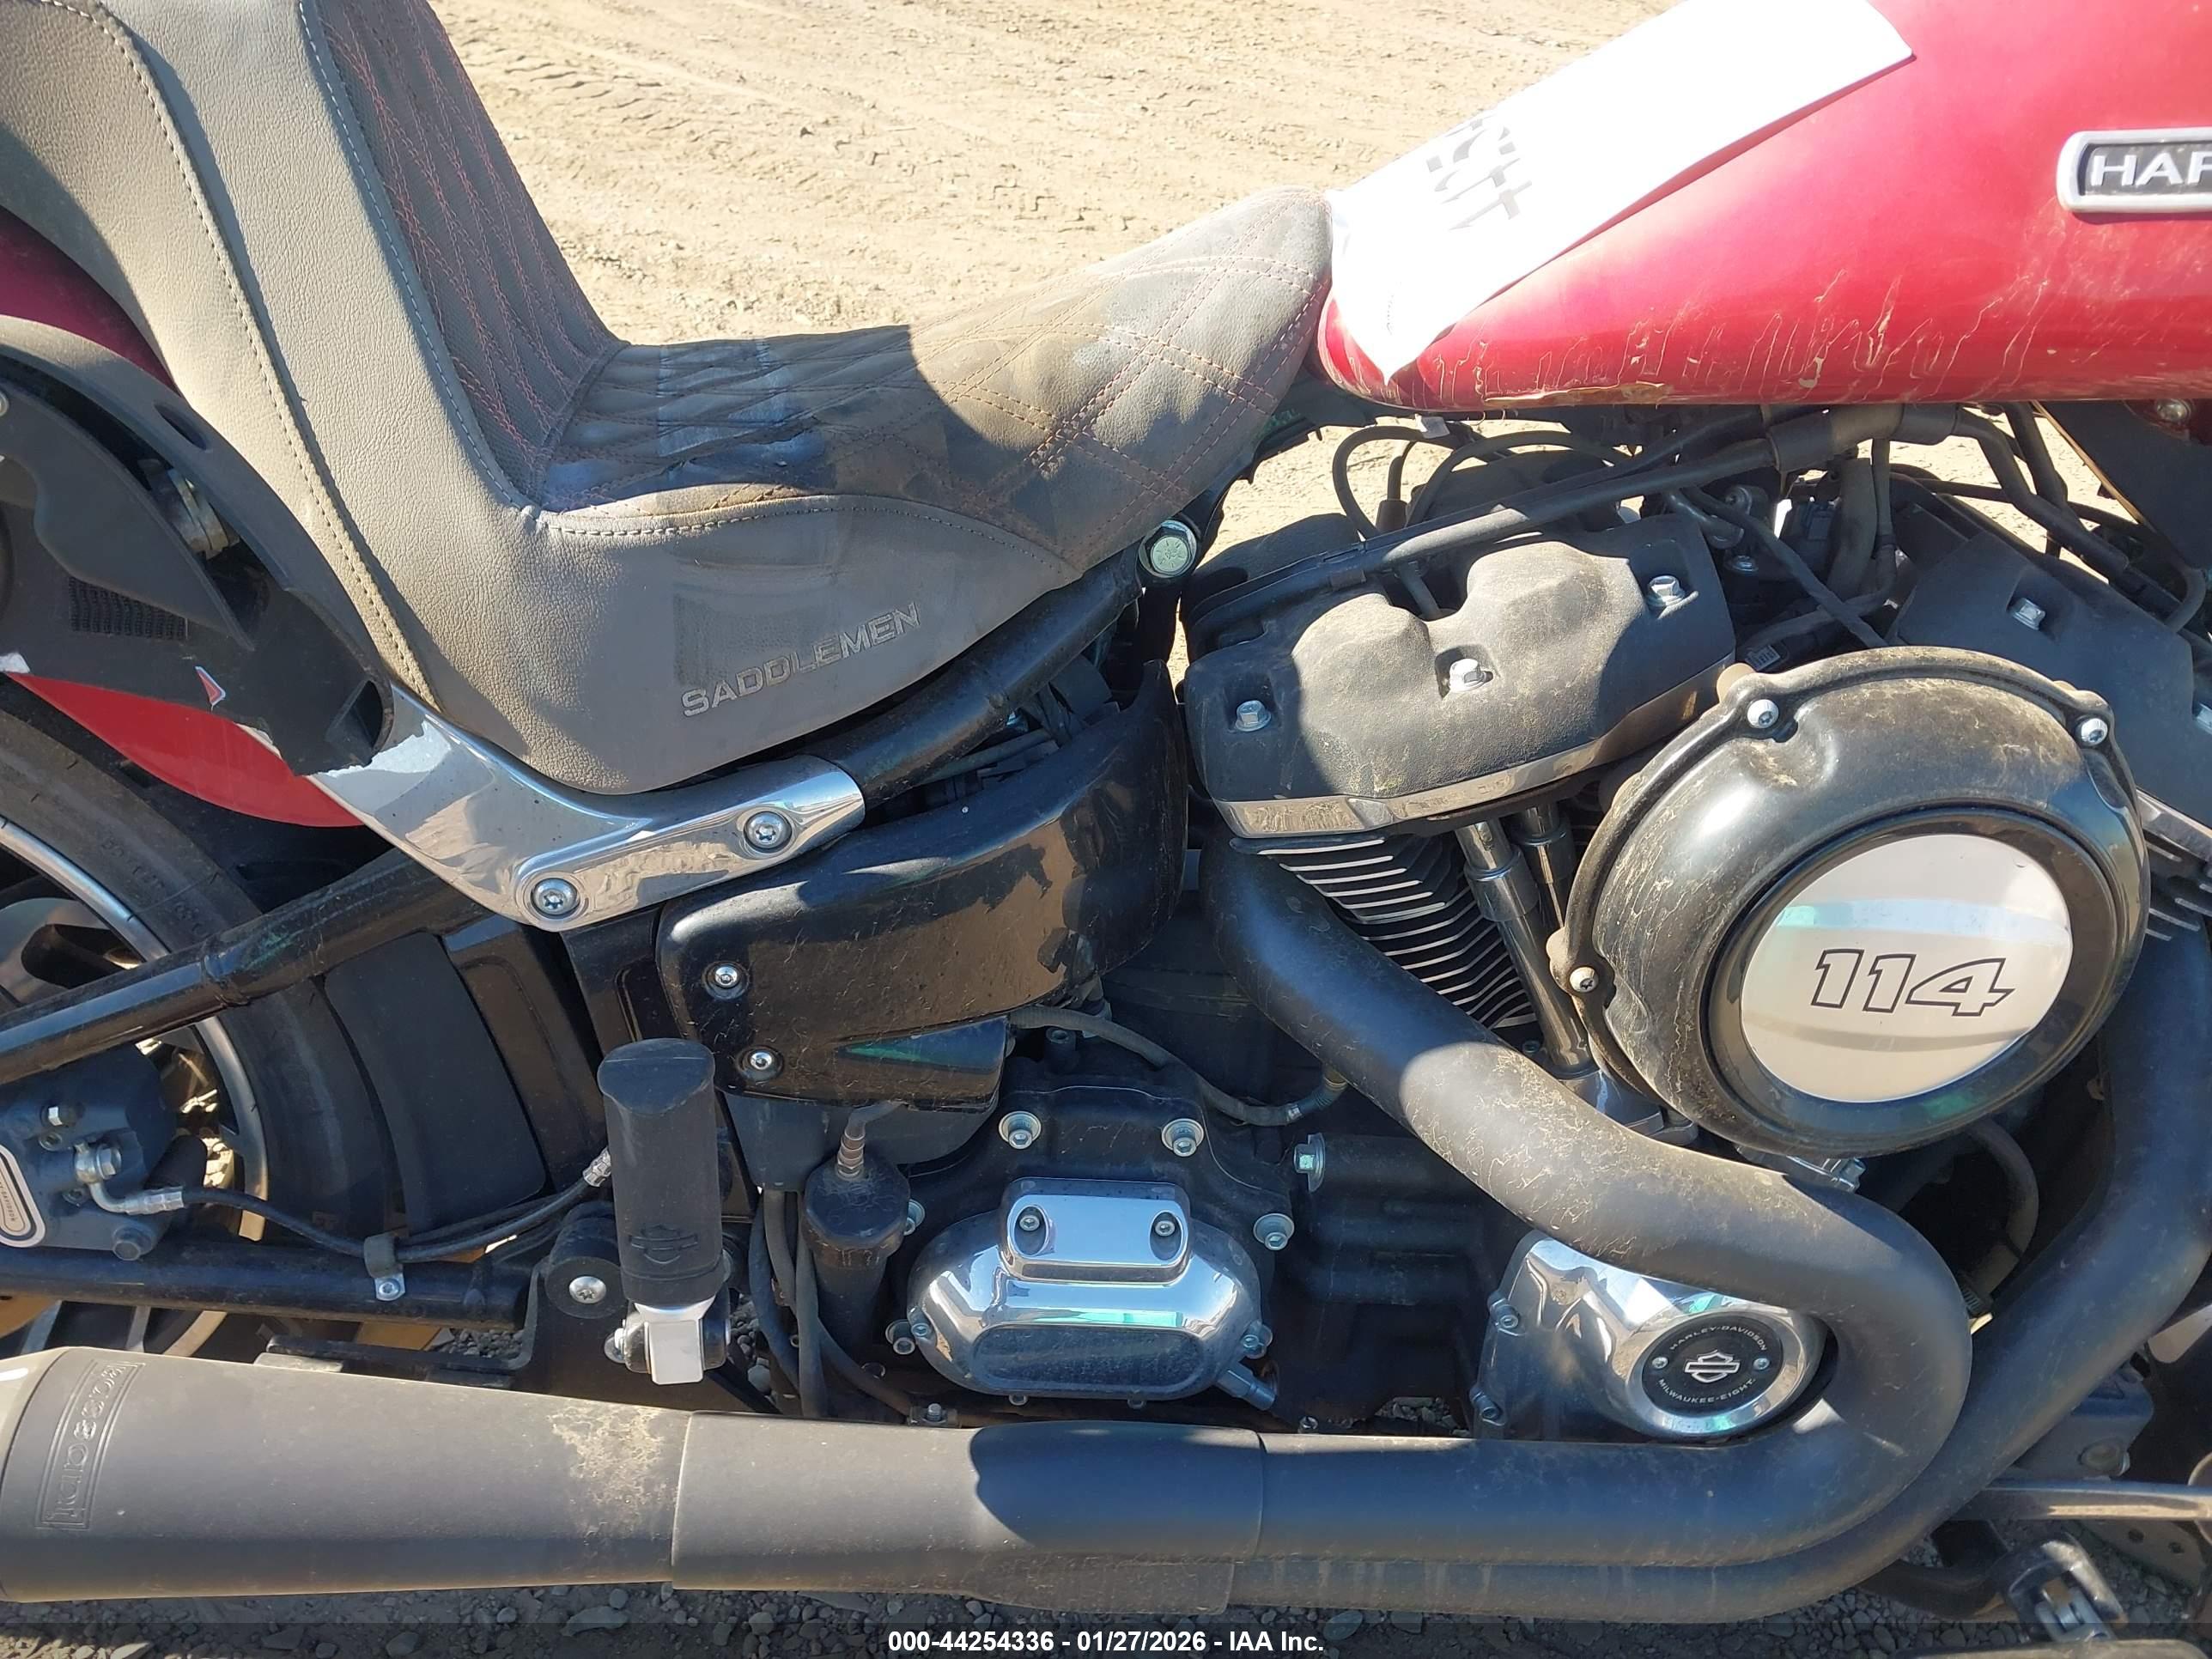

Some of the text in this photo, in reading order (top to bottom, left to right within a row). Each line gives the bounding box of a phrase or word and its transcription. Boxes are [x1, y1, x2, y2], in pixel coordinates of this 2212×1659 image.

[680, 602, 921, 717] SADDLEMEN
[1810, 948, 2015, 1017] 114
[1669, 1325, 1768, 1351] HARLEY-DAVIDSON
